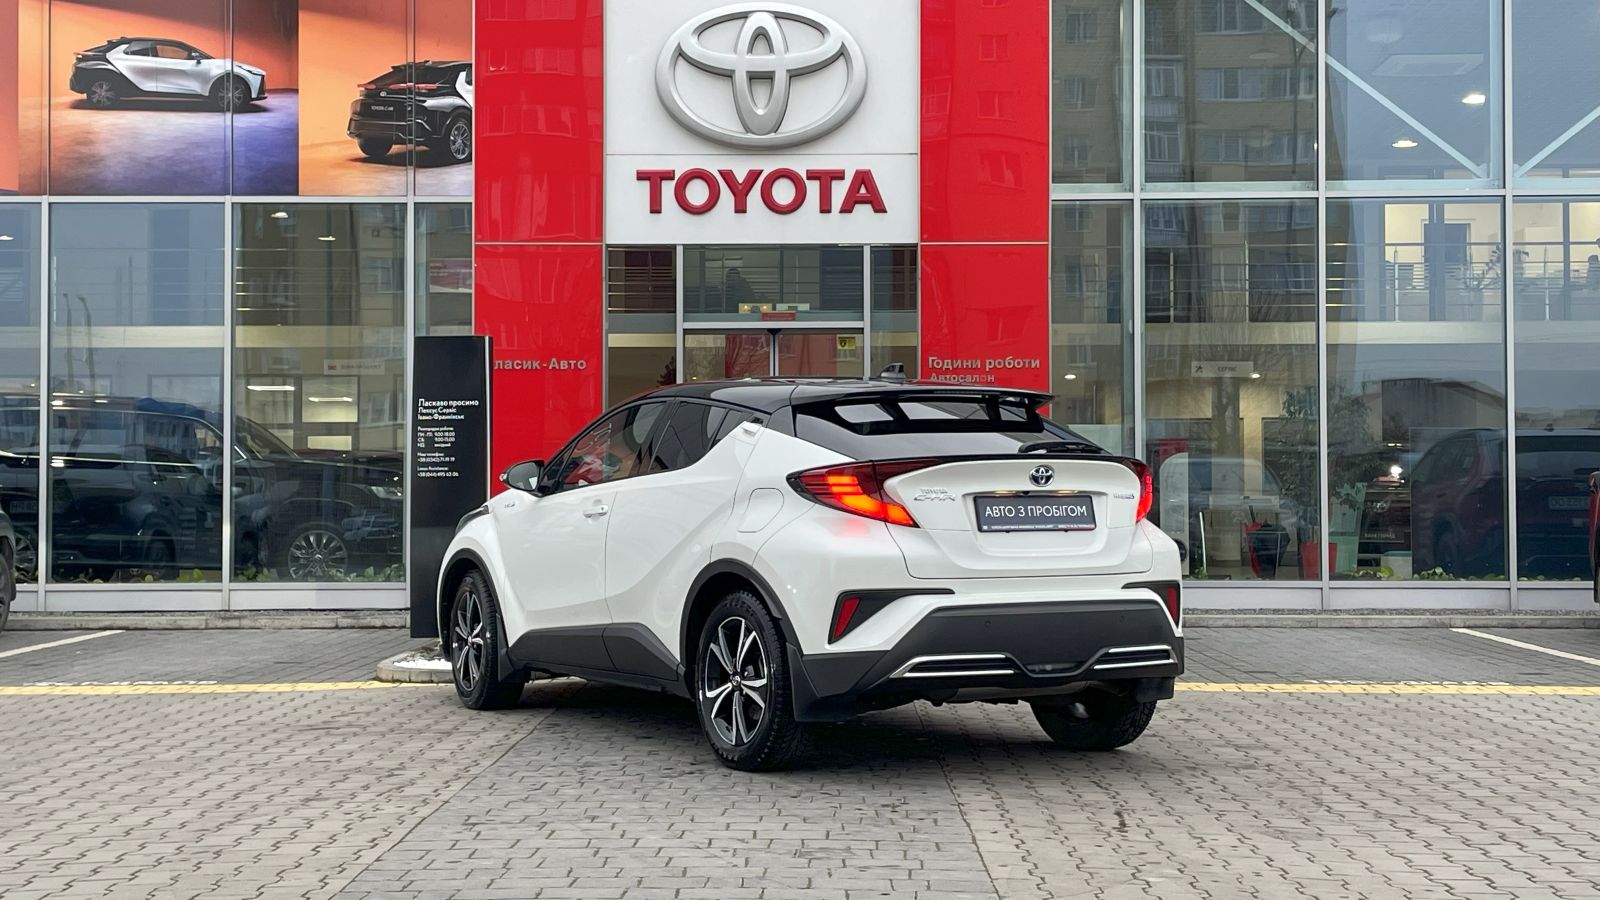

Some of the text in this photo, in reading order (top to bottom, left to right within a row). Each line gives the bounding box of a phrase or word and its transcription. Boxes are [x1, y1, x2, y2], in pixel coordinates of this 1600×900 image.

[636, 168, 888, 215] TOYOTA
[494, 357, 587, 370] ласик-Авто
[928, 356, 1041, 372] Години роботи
[930, 372, 995, 383] Автосалон
[418, 398, 448, 406] Ласкаво
[985, 505, 1087, 517] АВТО З ПРОБІГОМ
